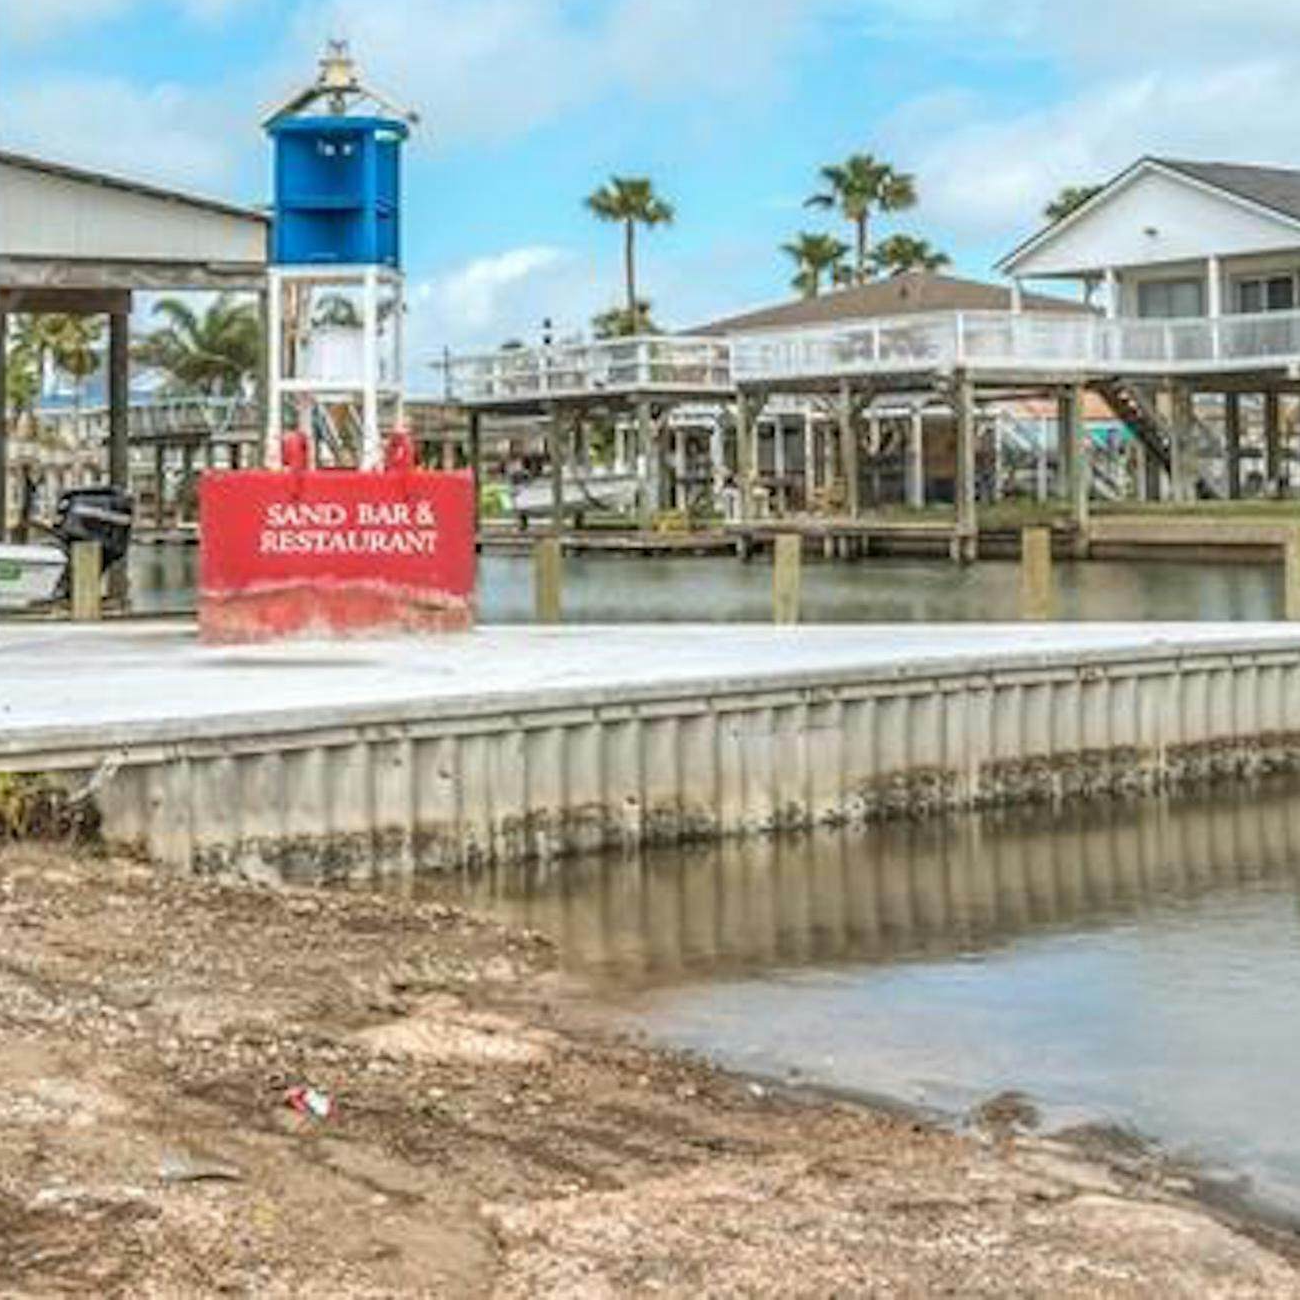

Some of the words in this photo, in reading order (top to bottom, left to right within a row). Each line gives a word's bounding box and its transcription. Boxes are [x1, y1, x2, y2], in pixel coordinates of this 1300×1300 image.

[266, 503, 348, 527] SAND
[358, 503, 411, 526] BAR
[416, 503, 436, 526] &
[260, 529, 438, 553] RESTAURANT
